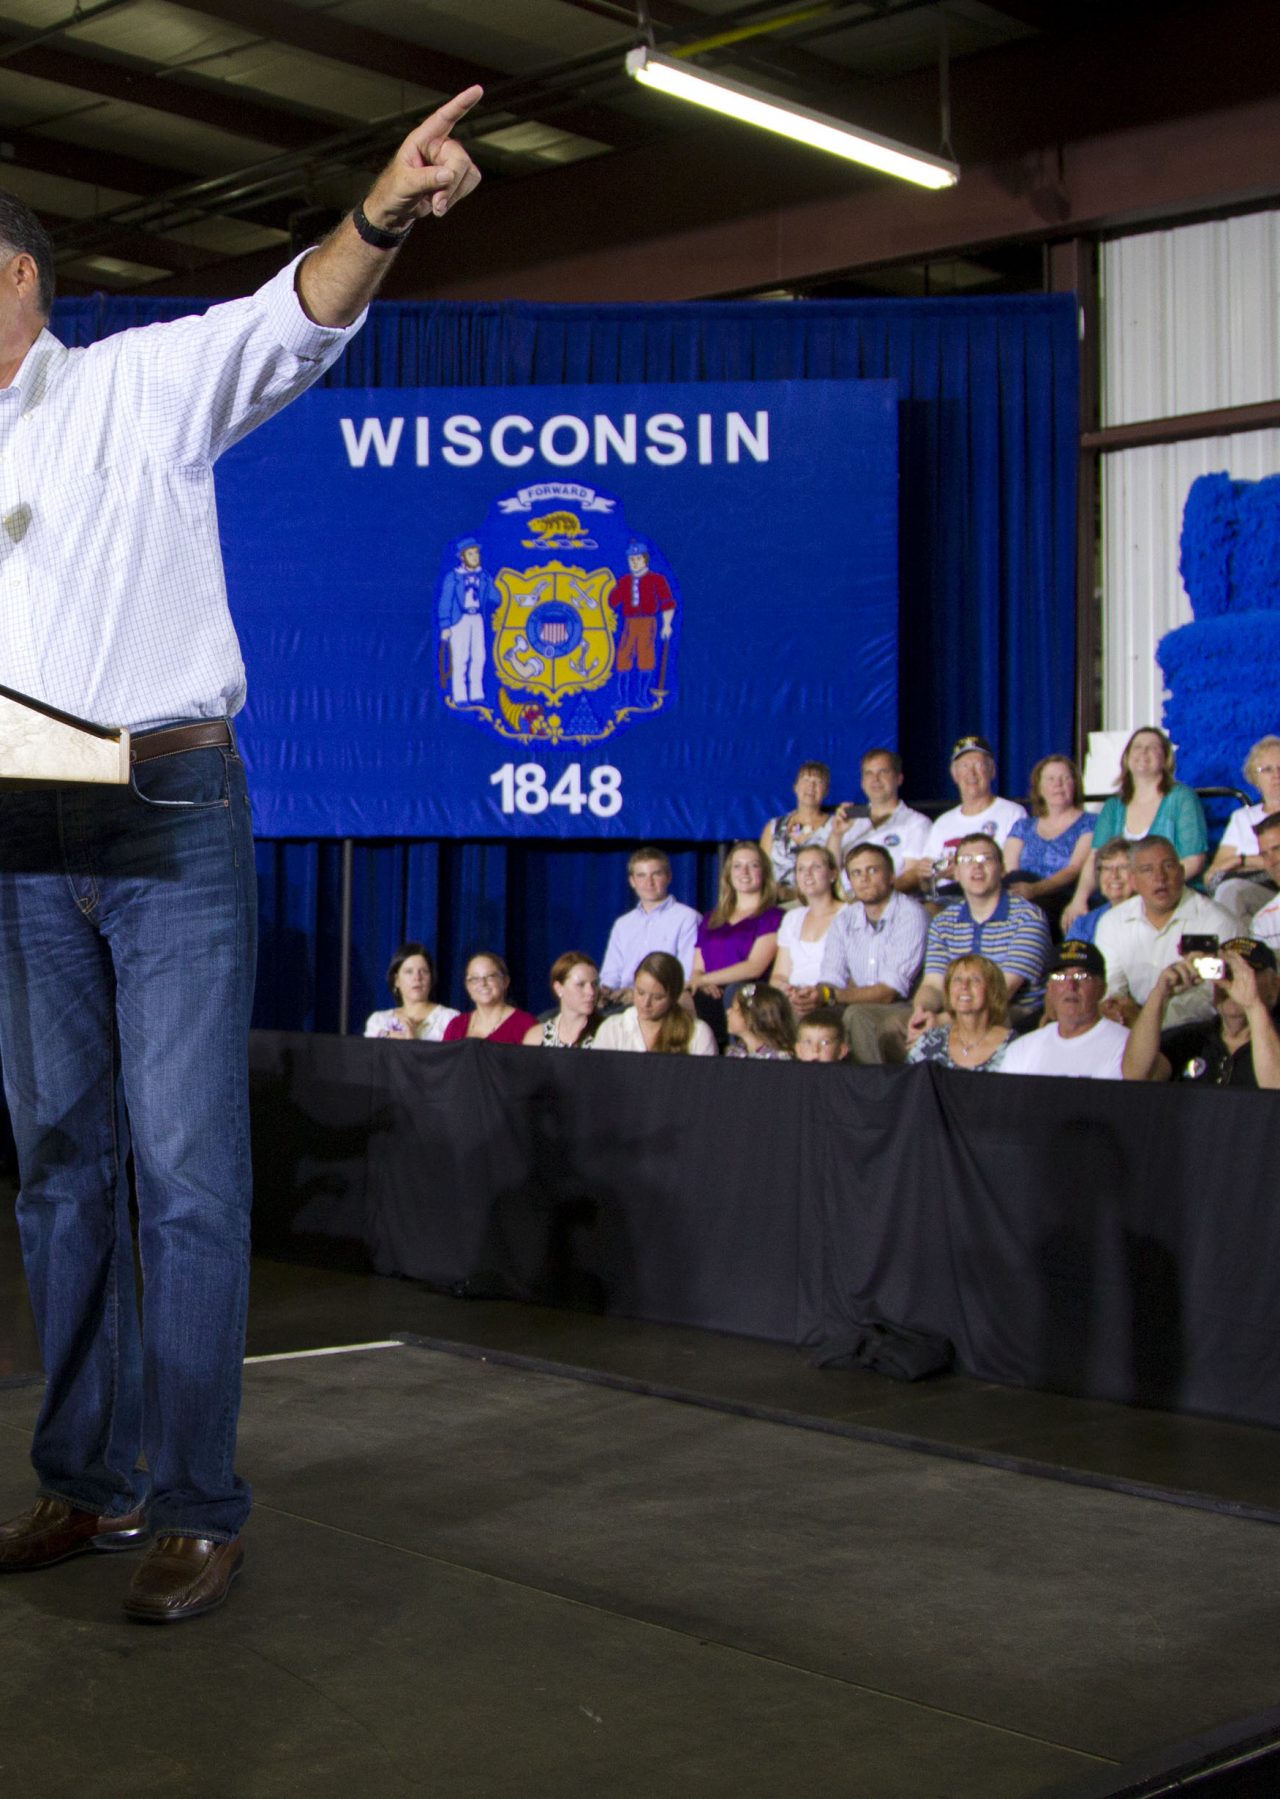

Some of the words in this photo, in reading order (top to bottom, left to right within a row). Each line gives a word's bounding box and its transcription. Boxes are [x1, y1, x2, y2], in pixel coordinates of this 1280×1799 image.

[340, 411, 770, 468] WISCONSIN
[528, 485, 588, 498] FORWARD
[490, 762, 623, 817] 1848
